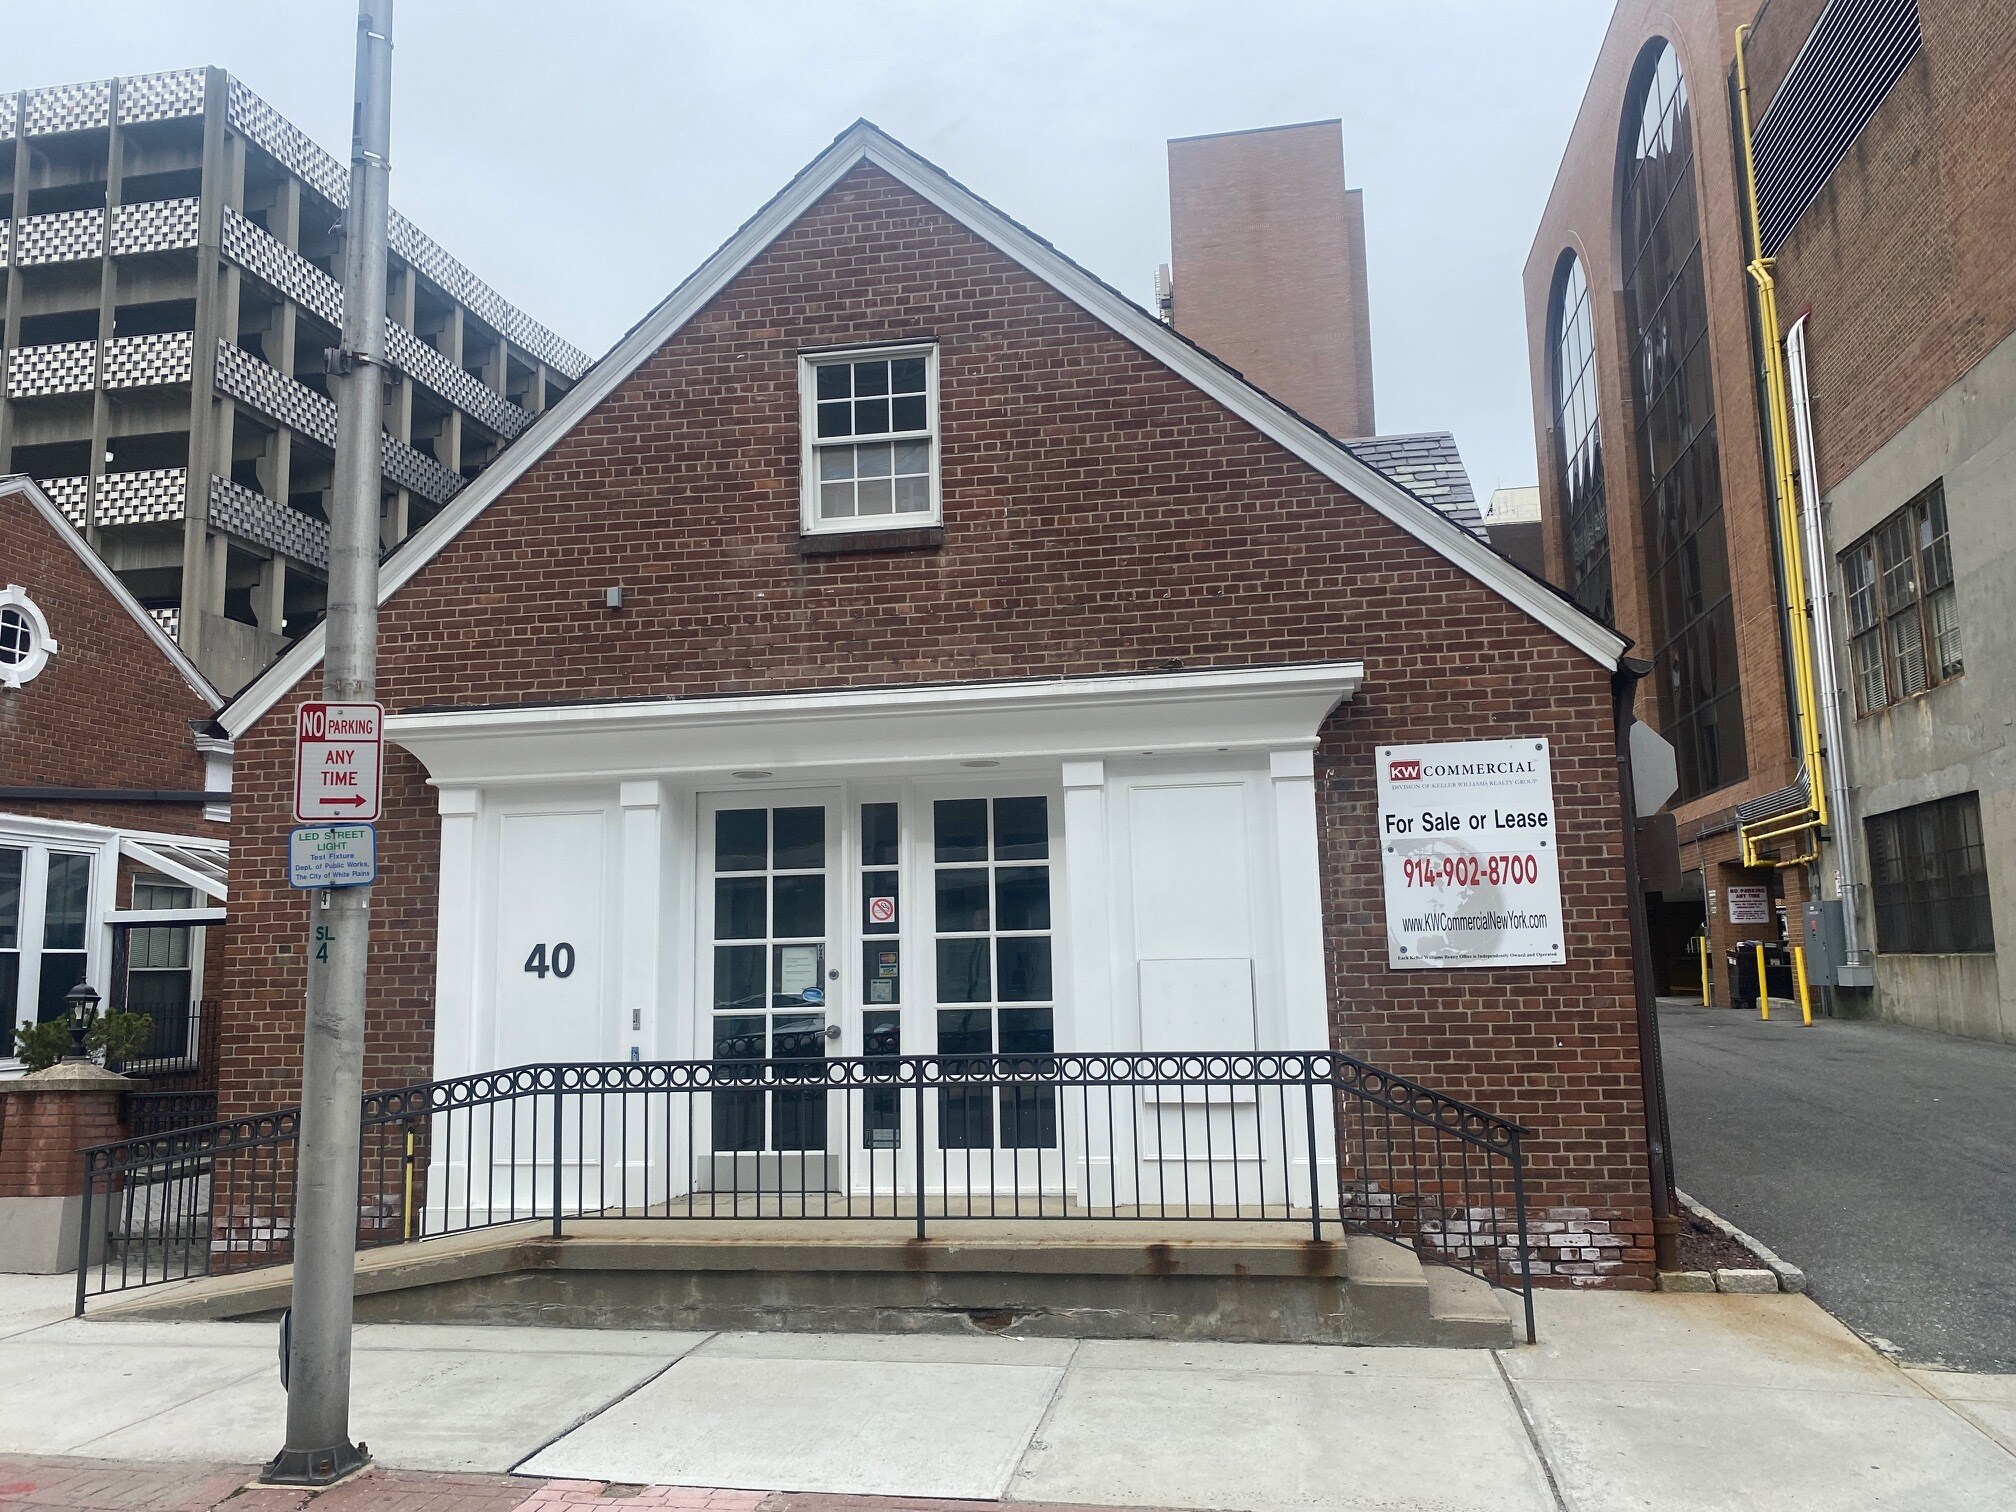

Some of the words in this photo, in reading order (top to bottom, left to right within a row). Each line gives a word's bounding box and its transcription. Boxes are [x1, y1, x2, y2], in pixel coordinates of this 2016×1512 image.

[302, 711, 325, 737] NO
[328, 720, 373, 734] PARKING
[325, 750, 355, 764] ANY
[321, 771, 358, 786] TIME
[1391, 766, 1419, 778] KW
[1423, 761, 1536, 777] COMMERCIAL
[1385, 814, 1414, 834] For
[1422, 811, 1461, 832] Sale
[1469, 814, 1486, 830] or
[1494, 809, 1548, 829] Lease
[298, 832, 320, 841] LED
[324, 830, 365, 840] STREET
[317, 842, 347, 851] LIGHT
[1403, 854, 1538, 888] 914-902-8700
[1402, 910, 1548, 933] www.KWCommercialNewYork.com
[315, 925, 336, 941] SL
[316, 942, 329, 964] 4
[524, 942, 576, 979] 40
